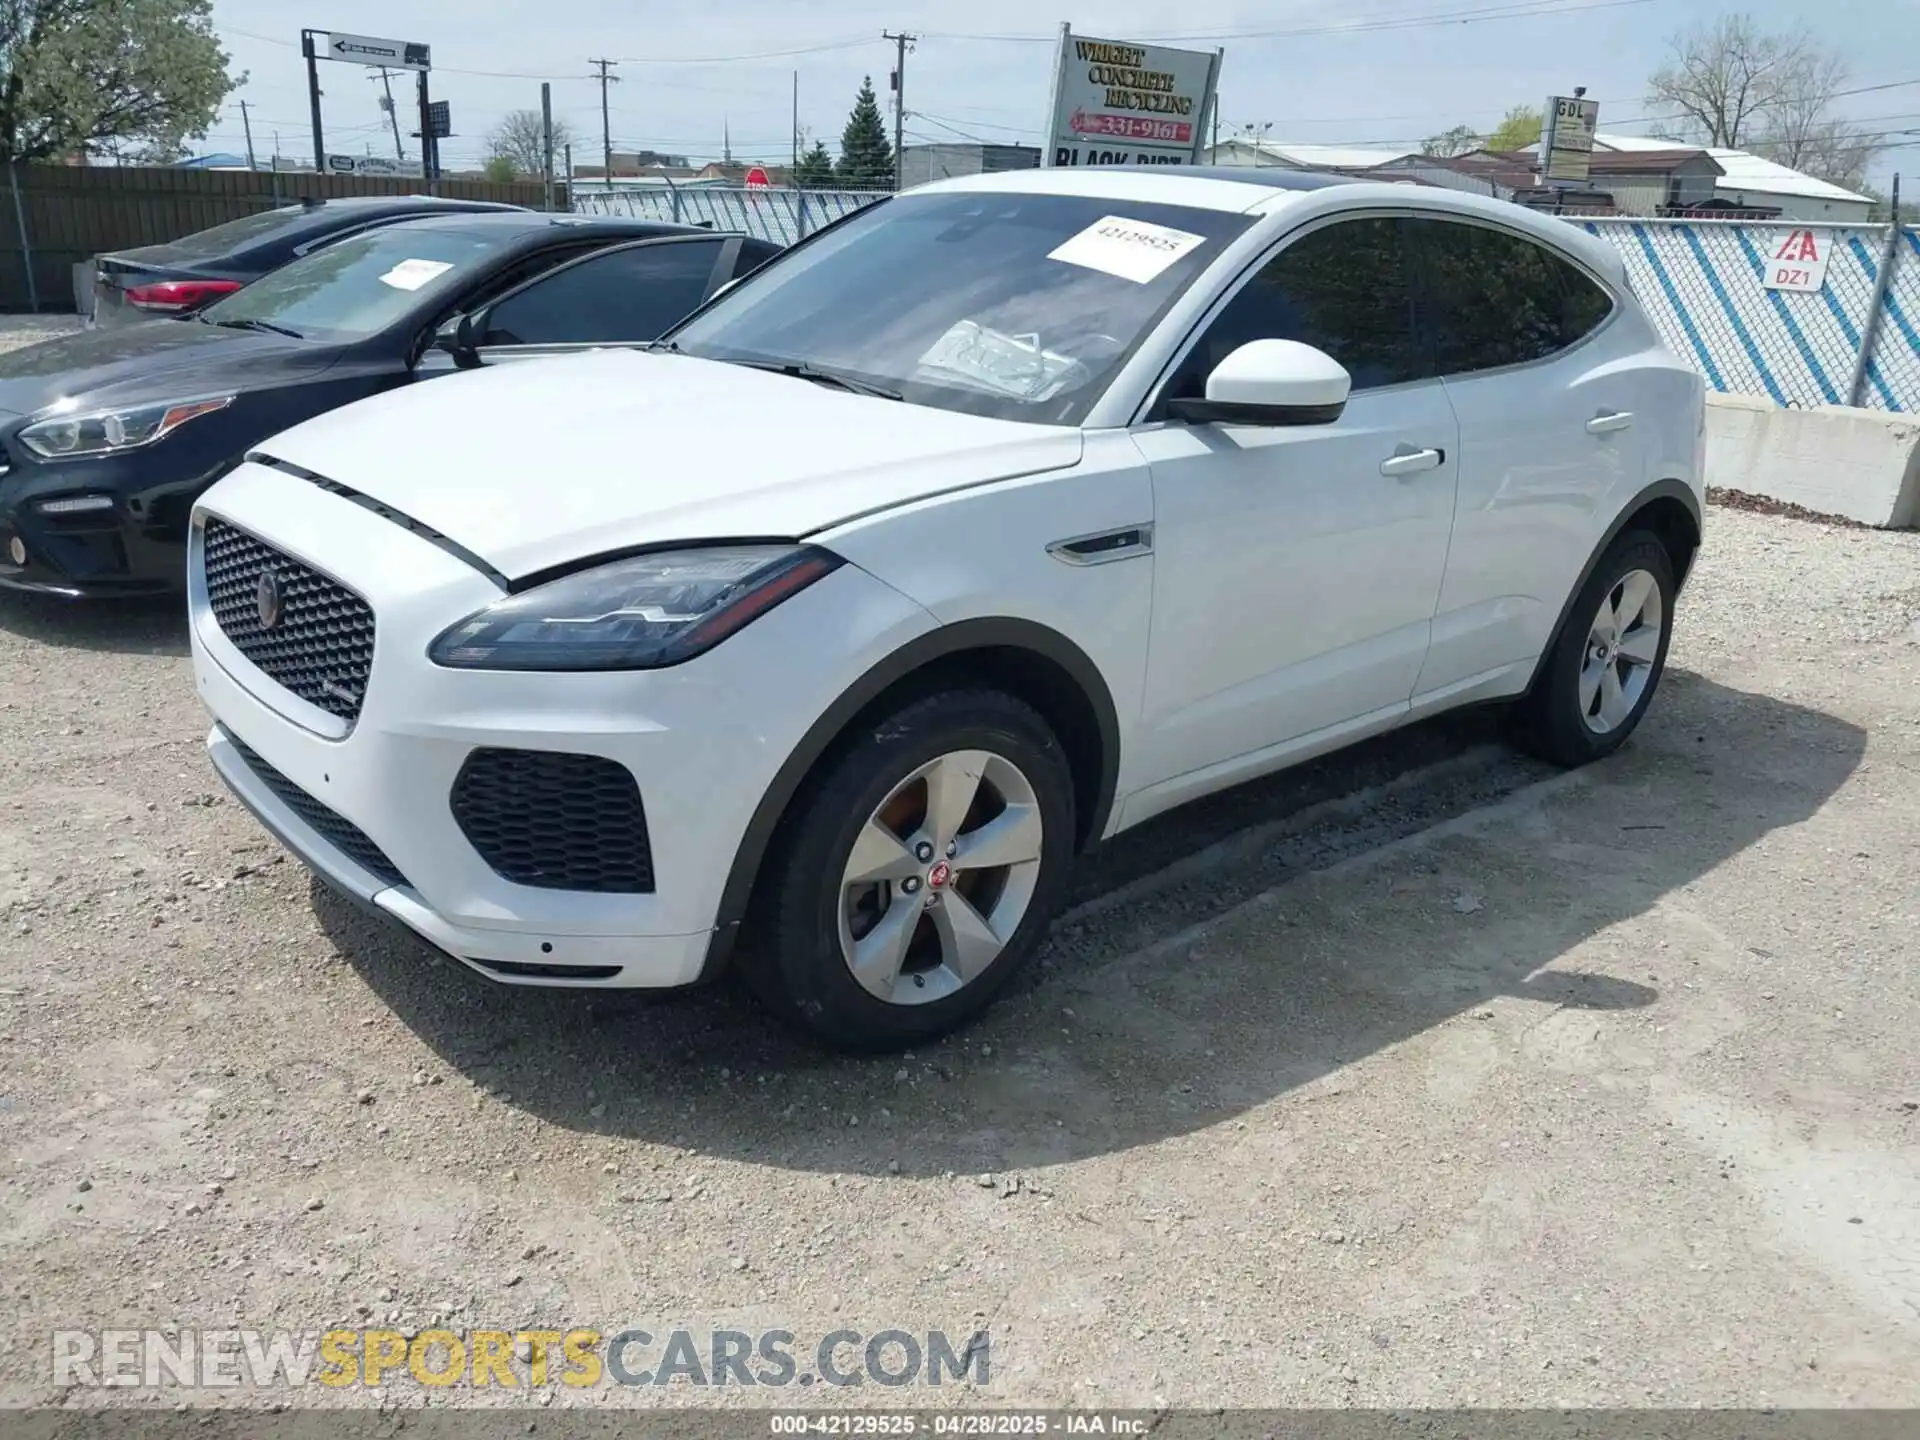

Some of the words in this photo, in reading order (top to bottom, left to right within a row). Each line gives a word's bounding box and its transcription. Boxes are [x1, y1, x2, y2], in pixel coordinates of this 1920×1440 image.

[1076, 41, 1145, 67] WRIGHT
[1088, 67, 1176, 92] CONCRETE
[1104, 88, 1193, 115] RECYCLING
[1558, 102, 1583, 118] GDL
[1101, 116, 1178, 140] 331-9161
[1776, 269, 1810, 285] DZ1
